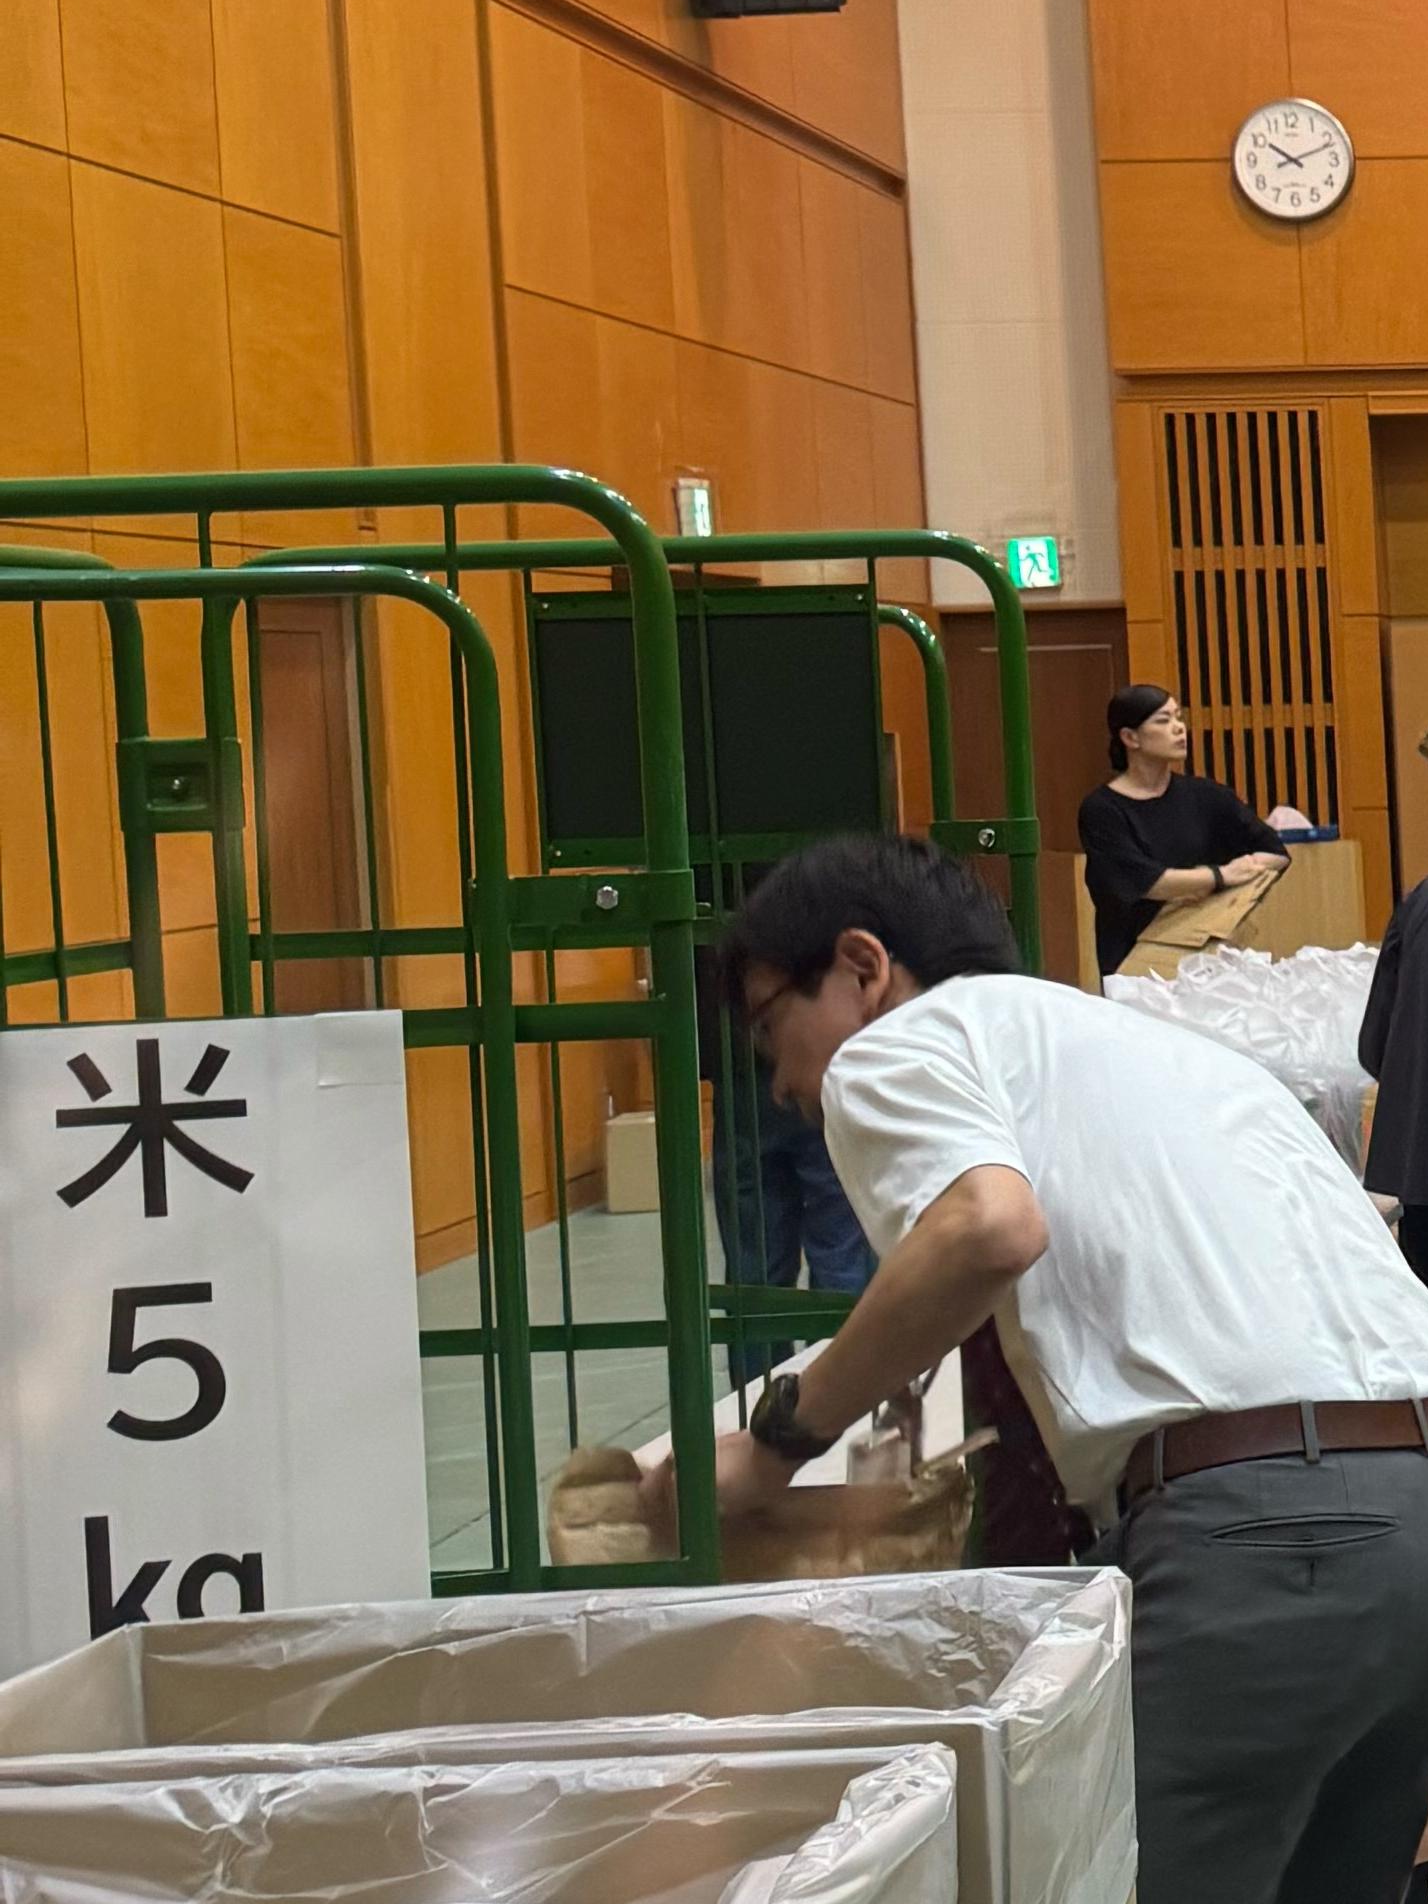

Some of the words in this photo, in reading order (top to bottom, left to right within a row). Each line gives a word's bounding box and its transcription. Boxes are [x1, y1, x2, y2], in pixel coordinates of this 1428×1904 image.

[1266, 117, 1279, 134] 11
[1284, 112, 1299, 128] 12
[1252, 133, 1267, 148] 10
[1322, 131, 1335, 147] 2
[1246, 152, 1257, 168] 9
[1329, 152, 1340, 167] 3
[1255, 174, 1267, 190] 8
[1324, 173, 1334, 188] 4
[1271, 187, 1281, 203] 7
[1290, 192, 1301, 207] 6
[1310, 187, 1321, 203] 5
[56, 1039, 255, 1217] 米
